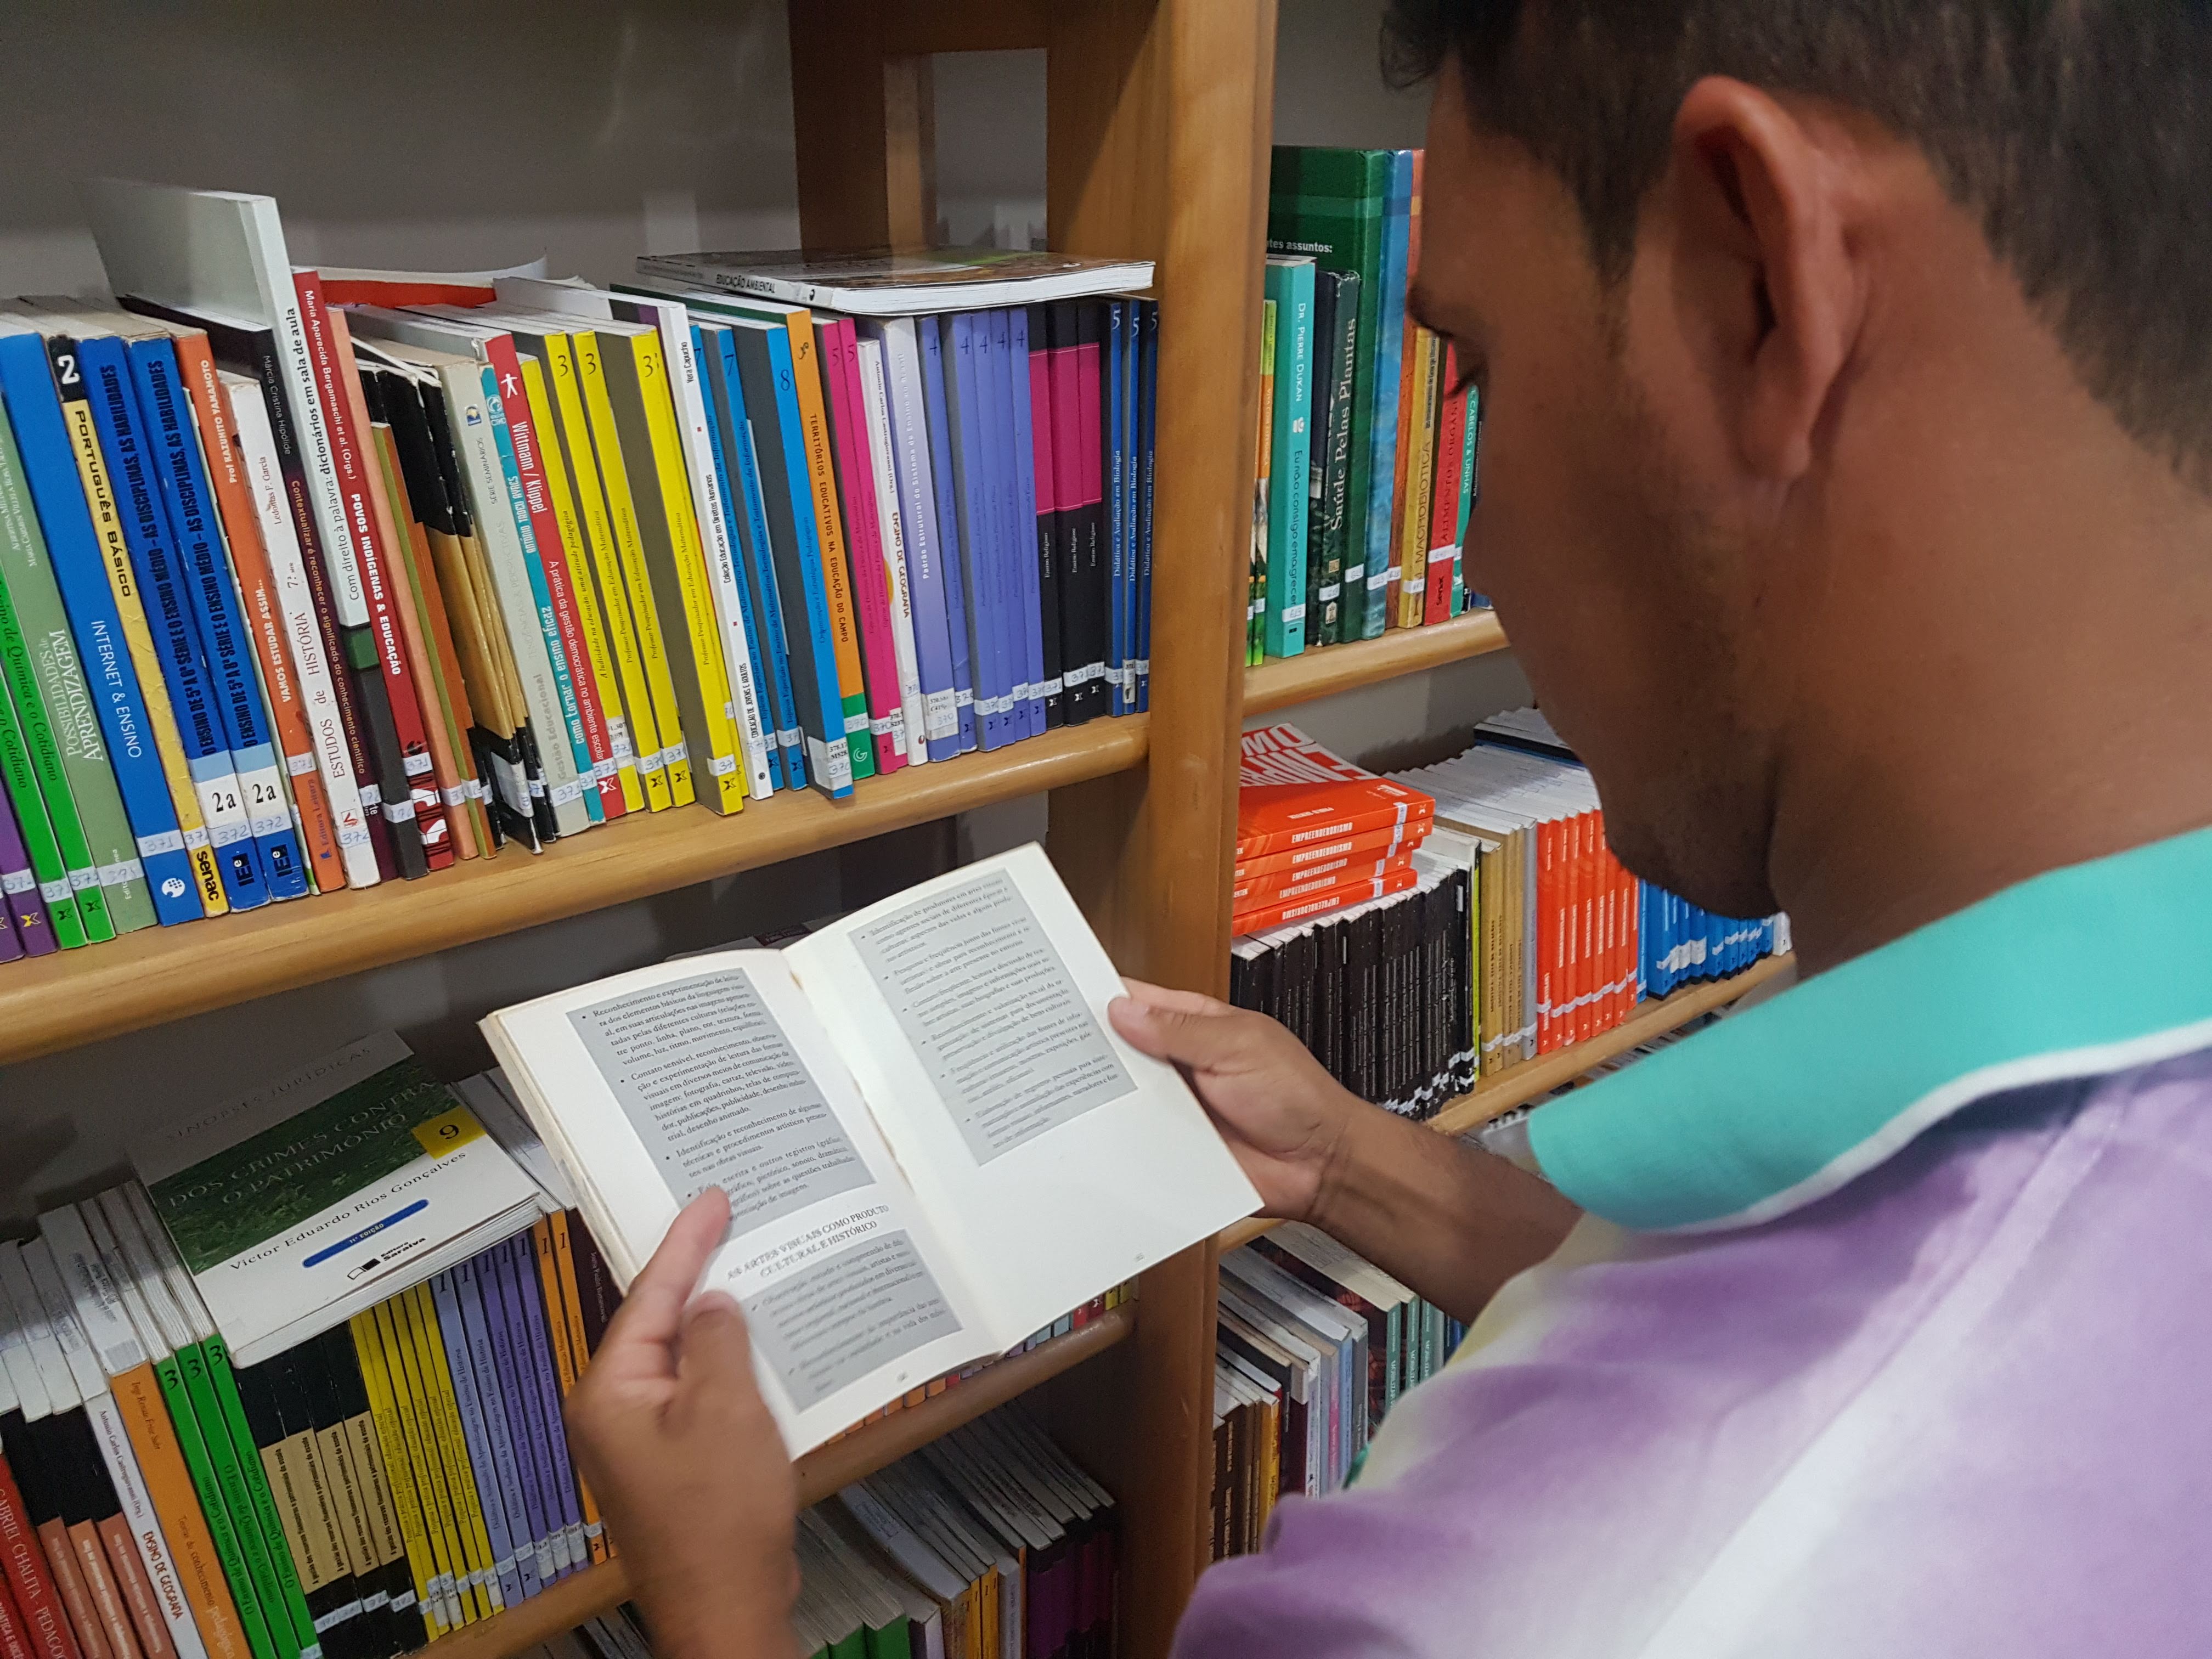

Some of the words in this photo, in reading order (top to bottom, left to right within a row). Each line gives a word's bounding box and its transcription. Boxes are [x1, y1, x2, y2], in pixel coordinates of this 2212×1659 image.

[1285, 239, 1333, 253] assuntos:
[716, 273, 744, 288] EDUCAÇÃO
[746, 278, 776, 294] AMBIENTAL
[303, 289, 319, 317] Maria
[1297, 303, 1306, 323] DR.
[284, 307, 300, 337] aula
[291, 338, 304, 356] de
[309, 318, 330, 365] Aparecida
[680, 341, 692, 368] Capucho
[1296, 326, 1305, 360] PIERRE
[58, 354, 80, 385] 2
[295, 357, 311, 383] sala
[557, 355, 569, 377] 3
[585, 353, 597, 375] 3
[685, 368, 694, 383] Vera
[1339, 318, 1357, 400] Plantas
[148, 359, 178, 433] HABILIDADES
[199, 359, 221, 415] YAMAMOTO
[262, 354, 276, 383] Márcia
[269, 385, 284, 419] Cristina
[304, 385, 315, 405] em
[320, 366, 343, 425] Bergamaschi
[780, 369, 791, 391] 8
[1295, 363, 1304, 402] DUKAN
[213, 416, 232, 463] KAZUHITO
[1334, 405, 1351, 463] Pelas
[1466, 399, 1476, 446] CABELOS
[307, 408, 331, 476] dicionários
[511, 420, 538, 471] Wittmann
[809, 413, 826, 477] TERRITÓRIOS
[1294, 450, 1302, 463] Eu
[224, 463, 238, 483] Prof
[258, 456, 271, 481] Garcia
[338, 447, 356, 481] (Orgs.)
[1113, 450, 1121, 483] Biologia
[1293, 465, 1301, 489] não
[1462, 458, 1471, 494] UNHAS
[169, 447, 200, 518] DISCIPLINAS,
[322, 475, 345, 523] palavra:
[523, 478, 548, 515] Klippel
[704, 473, 716, 501] Humanos
[1329, 467, 1346, 531] Saúde
[75, 410, 114, 522] PORTUGUÊS
[106, 529, 133, 596] BÁSICO
[709, 501, 720, 524] Direitos
[819, 482, 834, 537] EDUCATIVOS
[1113, 499, 1122, 535] Avaliação
[1290, 492, 1301, 539] consigo
[559, 509, 579, 550] pedagógica
[591, 510, 607, 551] Matemática
[915, 501, 926, 546] Estrutural
[189, 540, 215, 577] MÉDIO
[335, 534, 353, 572] direito
[571, 549, 583, 575] atitude
[715, 534, 728, 561] Educação
[827, 540, 836, 553] NA
[602, 551, 617, 585] Educação
[828, 556, 843, 599] EDUCAÇÃO
[919, 549, 930, 579] Padrão
[1288, 540, 1299, 607] emagrecer
[201, 574, 224, 614] ENSINO
[346, 574, 359, 600] Com
[351, 493, 368, 533] POVOS
[360, 535, 385, 601] INDÍGENAS
[377, 614, 403, 676] EDUCAÇÃO
[549, 568, 566, 599] prática
[897, 566, 911, 618] GEOGRAFIA
[557, 597, 569, 610] da
[836, 602, 844, 613] DO
[291, 479, 313, 547] Contextualizar
[308, 555, 327, 606] reconhecer
[321, 614, 340, 663] significado
[336, 676, 357, 735] conhecimento
[349, 735, 366, 774] científico
[538, 605, 558, 639] eficaz
[558, 609, 576, 639] gestão
[838, 617, 848, 642] CAMPO
[91, 618, 123, 690] INTERNET
[212, 628, 235, 659] SÉRIE
[263, 620, 282, 665] ESTUDAR
[291, 611, 321, 676] HISTÓRIA
[549, 639, 567, 672] ensino
[591, 637, 607, 672] ludicidade
[567, 638, 588, 686] democrática
[48, 627, 104, 764] APRENDIZAGEM
[111, 690, 127, 703] &
[275, 666, 292, 703] VAMOS
[557, 682, 578, 718] tornar
[6, 644, 36, 699] Química
[31, 720, 63, 781] Cotidiano
[233, 703, 256, 740] ENSINO
[533, 673, 558, 741] Educacional
[582, 697, 600, 733] ambiente
[115, 704, 143, 759] ENSINO
[319, 717, 346, 778] ESTUDOS
[570, 718, 585, 745] como
[590, 732, 607, 761] escolar
[212, 791, 237, 812] 2a
[252, 781, 276, 804] 2a
[1291, 822, 1353, 844] EMPREENDEDORISMO
[1291, 842, 1353, 864] EMPREENDEDORISMO
[195, 849, 222, 903] senac
[592, 993, 656, 1018] Reconhecimento
[620, 1002, 661, 1020] elementos
[644, 1006, 686, 1025] articulações
[652, 1015, 689, 1033] diferentes
[630, 1064, 663, 1081] Contato
[658, 1059, 717, 1085] experimentação
[727, 1048, 750, 1060] leitura
[642, 1086, 670, 1101] visuais
[681, 1070, 712, 1087] diversos
[654, 1103, 688, 1121] histórias
[685, 1116, 719, 1134] desenho
[439, 1124, 459, 1140] 9
[675, 1132, 727, 1158] Identificação
[732, 1110, 788, 1135] reconhecimento
[722, 1127, 776, 1153] procedimentos
[229, 1130, 328, 1182] CRIMES
[230, 1243, 281, 1272] Victor
[283, 1209, 352, 1248] Eduardo
[353, 1191, 389, 1213] Rios
[390, 1150, 467, 1197] Gonçalves
[820, 1216, 851, 1235] COMO
[849, 1201, 890, 1225] PRODUTO
[826, 1216, 878, 1246] HISTÓRICO
[382, 1236, 427, 1262] Saraiva
[200, 1475, 222, 1520] Cotidiano
[218, 1530, 241, 1568] Química
[10, 1542, 43, 1600] CHALITA
[142, 1530, 163, 1562] ENSINO
[157, 1575, 184, 1621] GEOGRAFIA
